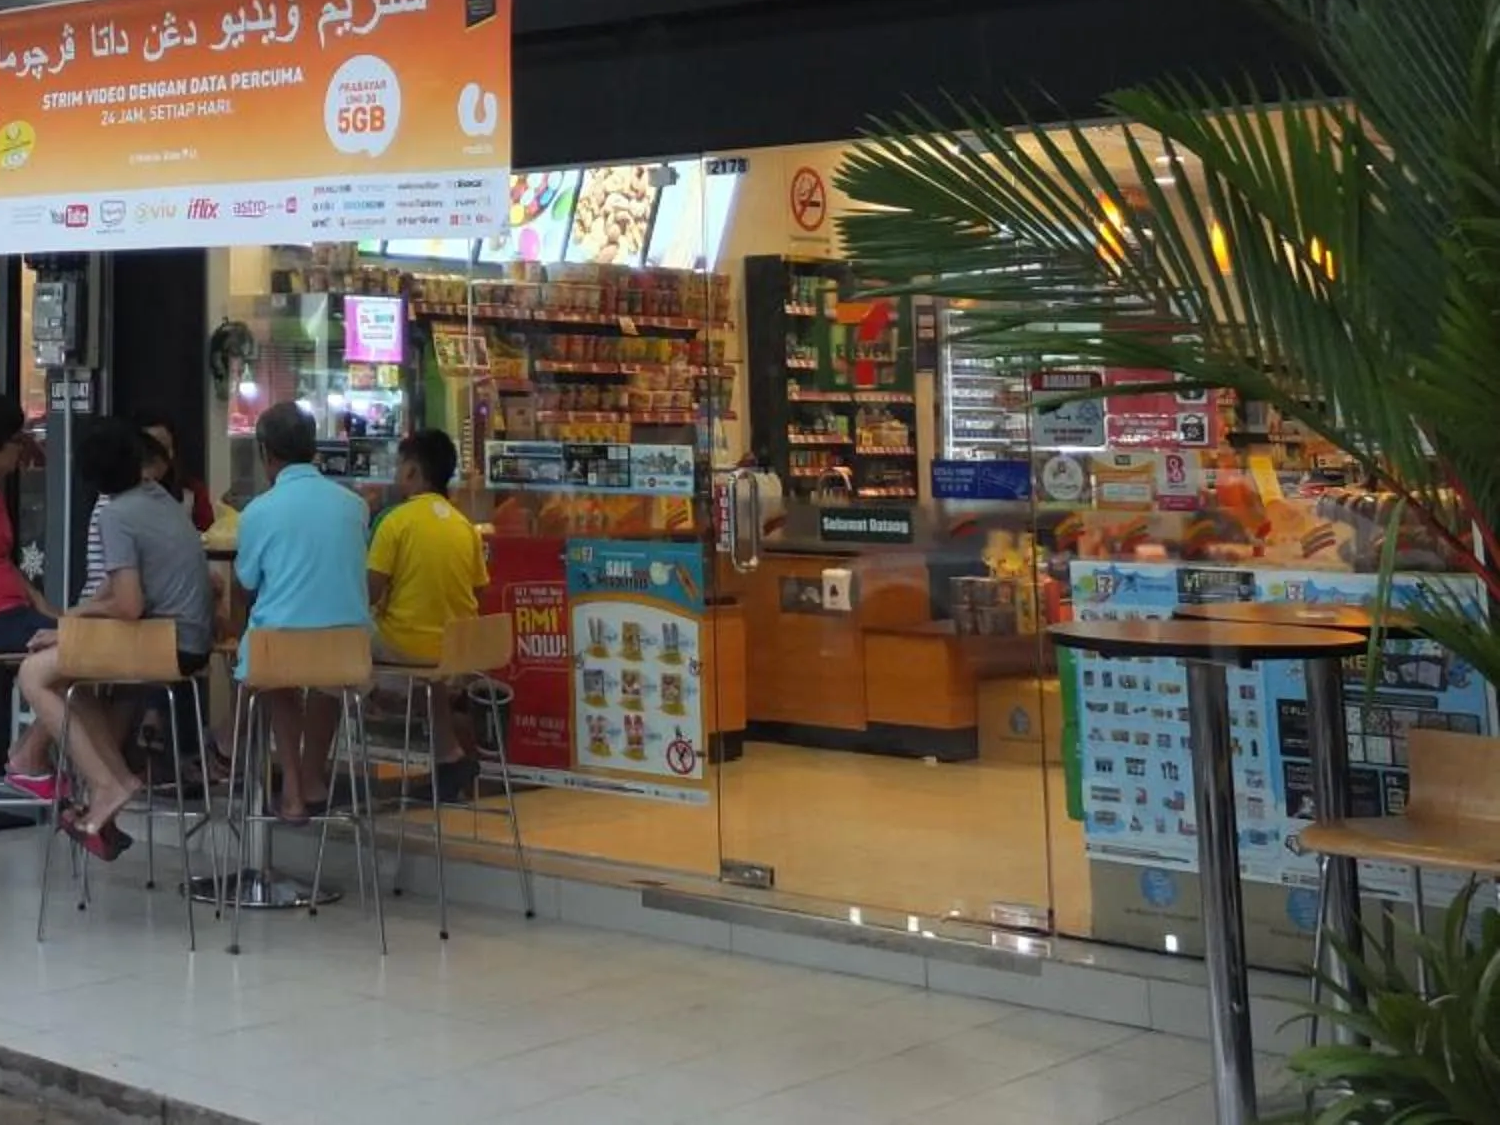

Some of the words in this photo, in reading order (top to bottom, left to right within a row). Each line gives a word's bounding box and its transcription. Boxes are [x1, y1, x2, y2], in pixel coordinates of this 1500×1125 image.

[42, 90, 83, 110] STRIM
[86, 87, 126, 106] VIDEO
[129, 81, 187, 102] DENGAN
[190, 75, 226, 94] DATA
[231, 66, 305, 91] PERCUMA
[100, 110, 115, 126] 24
[149, 101, 196, 121] SETIAP
[338, 105, 387, 134] 5GB
[187, 196, 221, 221] iflix
[823, 516, 866, 532] Selamat
[869, 518, 909, 534] Datang
[517, 634, 568, 658] NOW!
